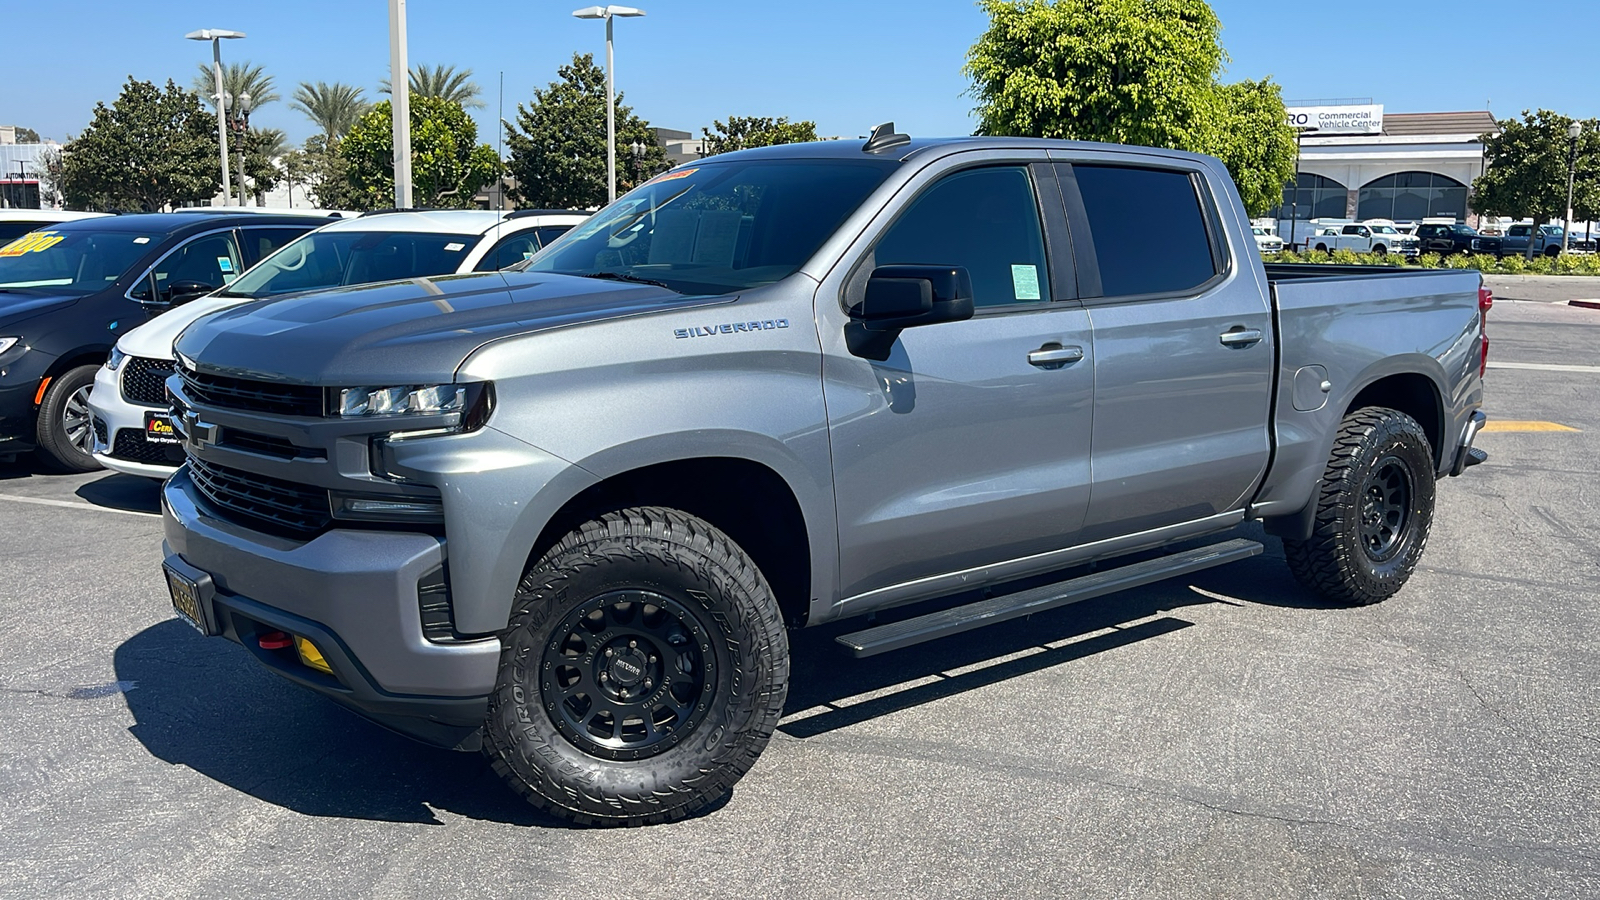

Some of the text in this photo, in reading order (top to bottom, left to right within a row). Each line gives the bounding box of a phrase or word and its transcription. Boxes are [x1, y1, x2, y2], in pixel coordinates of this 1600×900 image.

[1318, 111, 1372, 120] Commercial
[1318, 119, 1381, 128] Vehicle Center
[673, 318, 790, 339] SILVERADO
[511, 643, 597, 785] TAMAROCK
